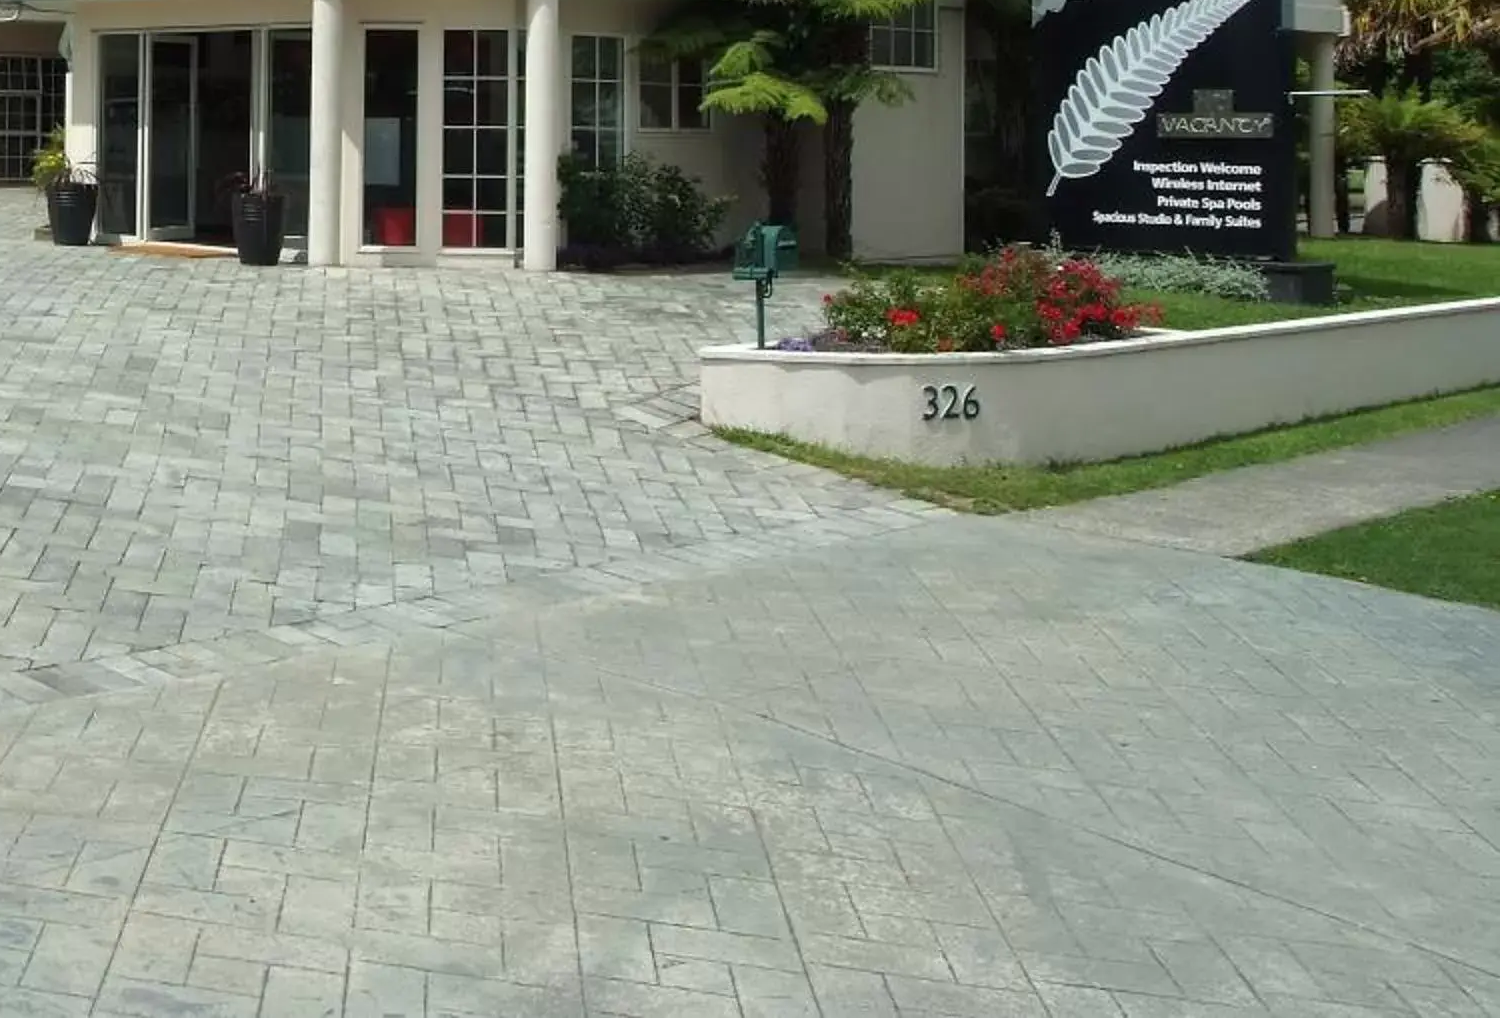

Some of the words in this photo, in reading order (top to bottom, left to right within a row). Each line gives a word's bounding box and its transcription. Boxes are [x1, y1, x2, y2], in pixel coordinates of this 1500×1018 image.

[1161, 117, 1272, 133] VACANCY
[1133, 160, 1198, 175] Inspection
[1199, 162, 1263, 175] Welcome
[1151, 177, 1204, 191] Wireless
[1207, 179, 1262, 192] Internet
[1157, 195, 1199, 209] Private
[1201, 197, 1225, 211] Spa
[1227, 198, 1262, 211] Pools
[1092, 210, 1136, 224] Spacious
[1138, 212, 1172, 225] Studio
[1174, 214, 1183, 225] &
[1185, 214, 1223, 229] Family
[1225, 215, 1262, 229] Suites
[922, 385, 979, 420] 326
